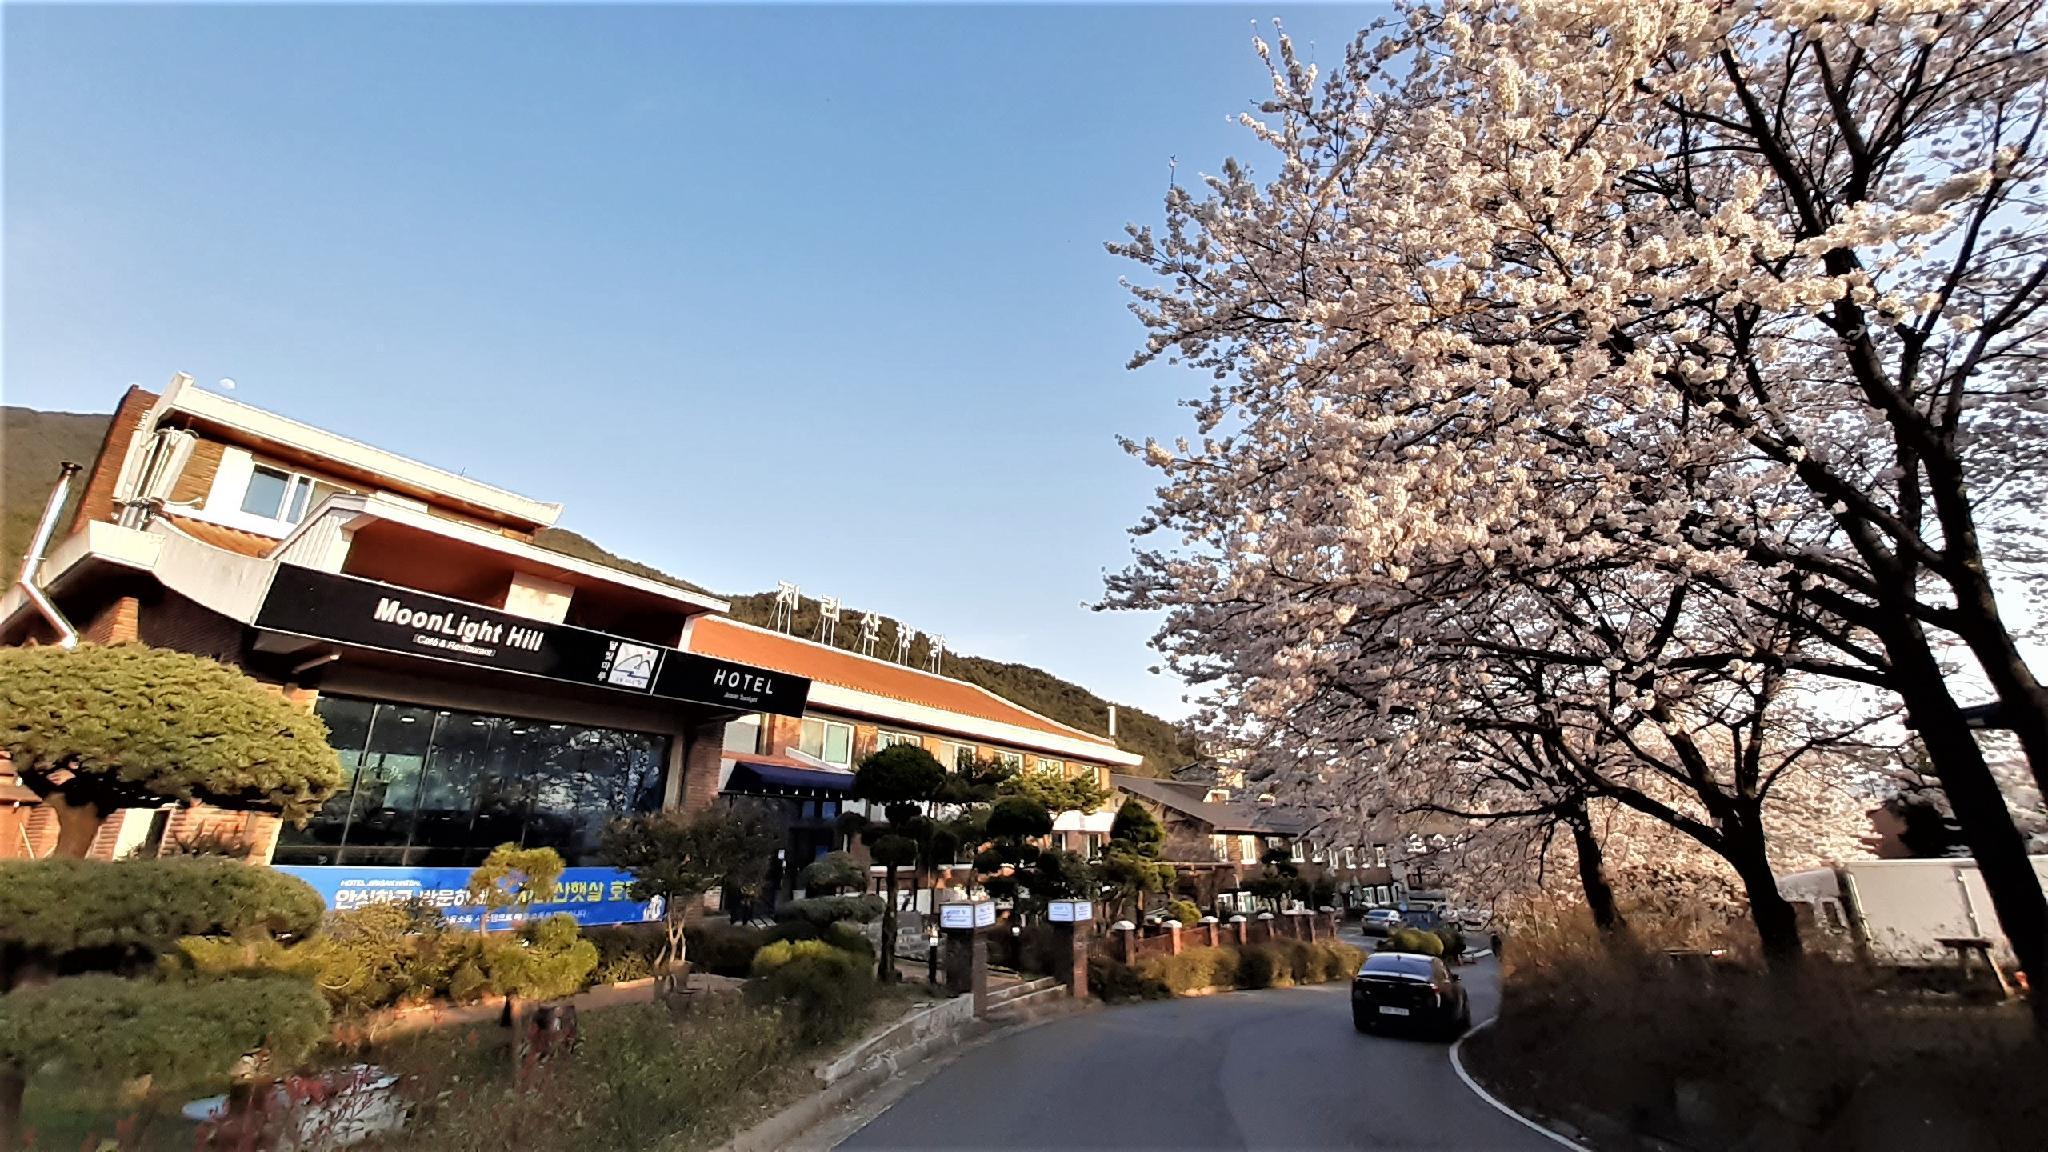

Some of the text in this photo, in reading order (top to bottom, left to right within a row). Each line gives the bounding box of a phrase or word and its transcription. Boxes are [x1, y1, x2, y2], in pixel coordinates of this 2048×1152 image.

[373, 597, 545, 651] MoonLight Hill
[713, 668, 774, 695] HOTEL
